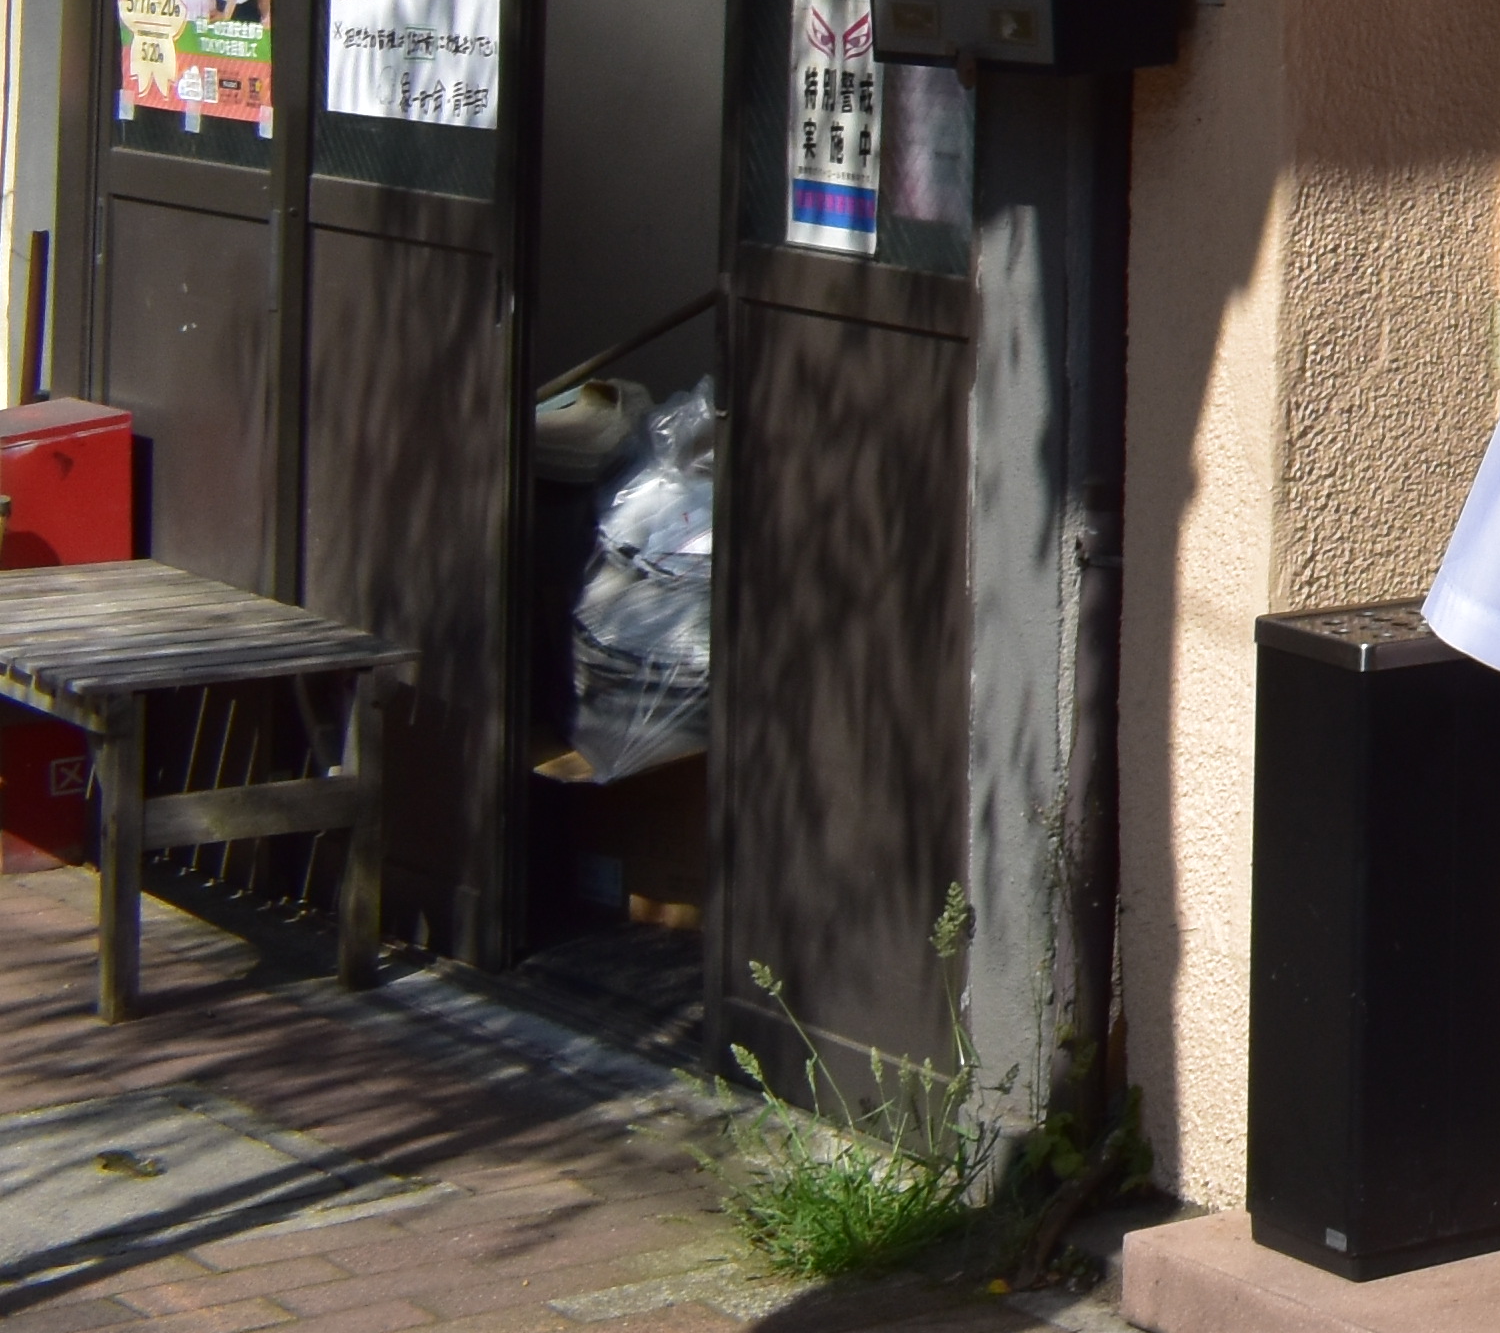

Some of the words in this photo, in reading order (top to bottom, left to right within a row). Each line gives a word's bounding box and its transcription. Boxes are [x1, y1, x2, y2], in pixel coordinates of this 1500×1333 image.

[804, 66, 874, 115] 特別警戒
[803, 118, 872, 167] 実施中
